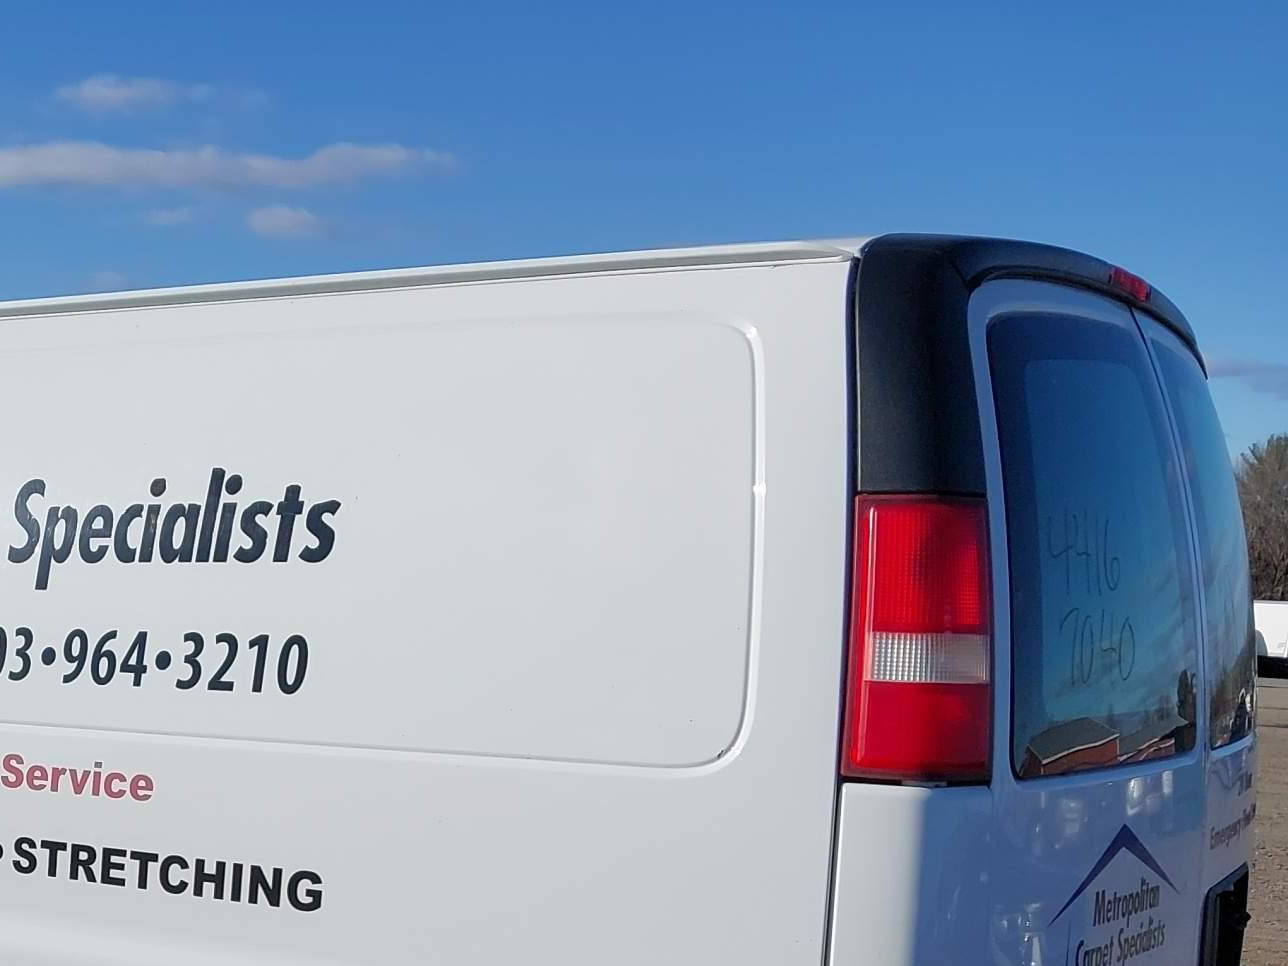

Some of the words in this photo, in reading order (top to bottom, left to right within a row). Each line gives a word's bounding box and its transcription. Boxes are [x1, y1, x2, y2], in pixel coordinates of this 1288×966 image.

[7, 467, 342, 590] Specialists
[0, 753, 155, 802] Service
[1093, 877, 1161, 927] Metropolitan
